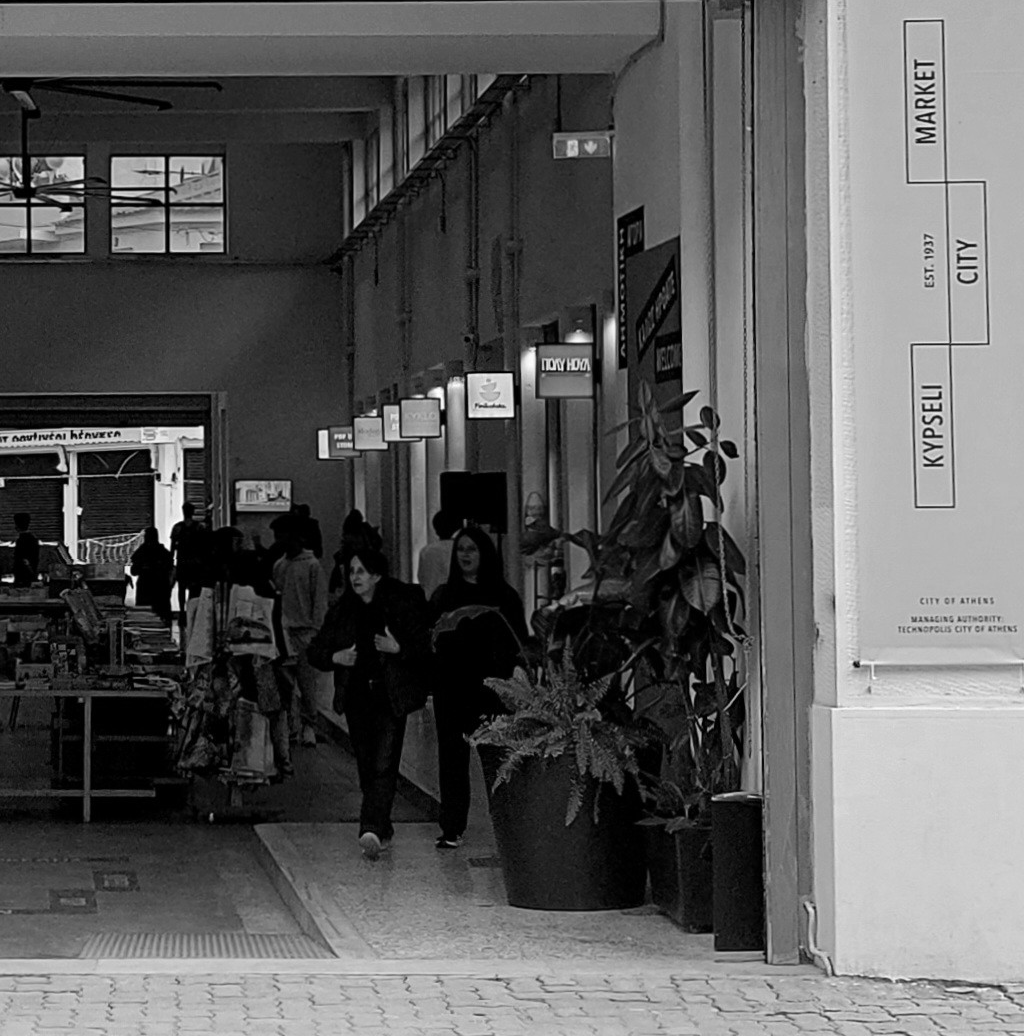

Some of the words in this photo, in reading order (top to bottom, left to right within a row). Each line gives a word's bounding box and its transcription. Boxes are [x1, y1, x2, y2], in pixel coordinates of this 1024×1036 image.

[913, 58, 937, 144] MARKET
[923, 233, 935, 261] 1937
[955, 239, 980, 285] CITY
[921, 385, 946, 468] KYPSELI
[919, 597, 940, 605] CITY
[944, 597, 955, 605] OF
[960, 596, 995, 605] ATHENS
[897, 625, 952, 634] TECHNOPOLIS
[954, 625, 972, 633] CITY
[974, 625, 985, 633] OF
[987, 624, 1018, 633] ATHENS
[910, 615, 955, 624] MANAGING
